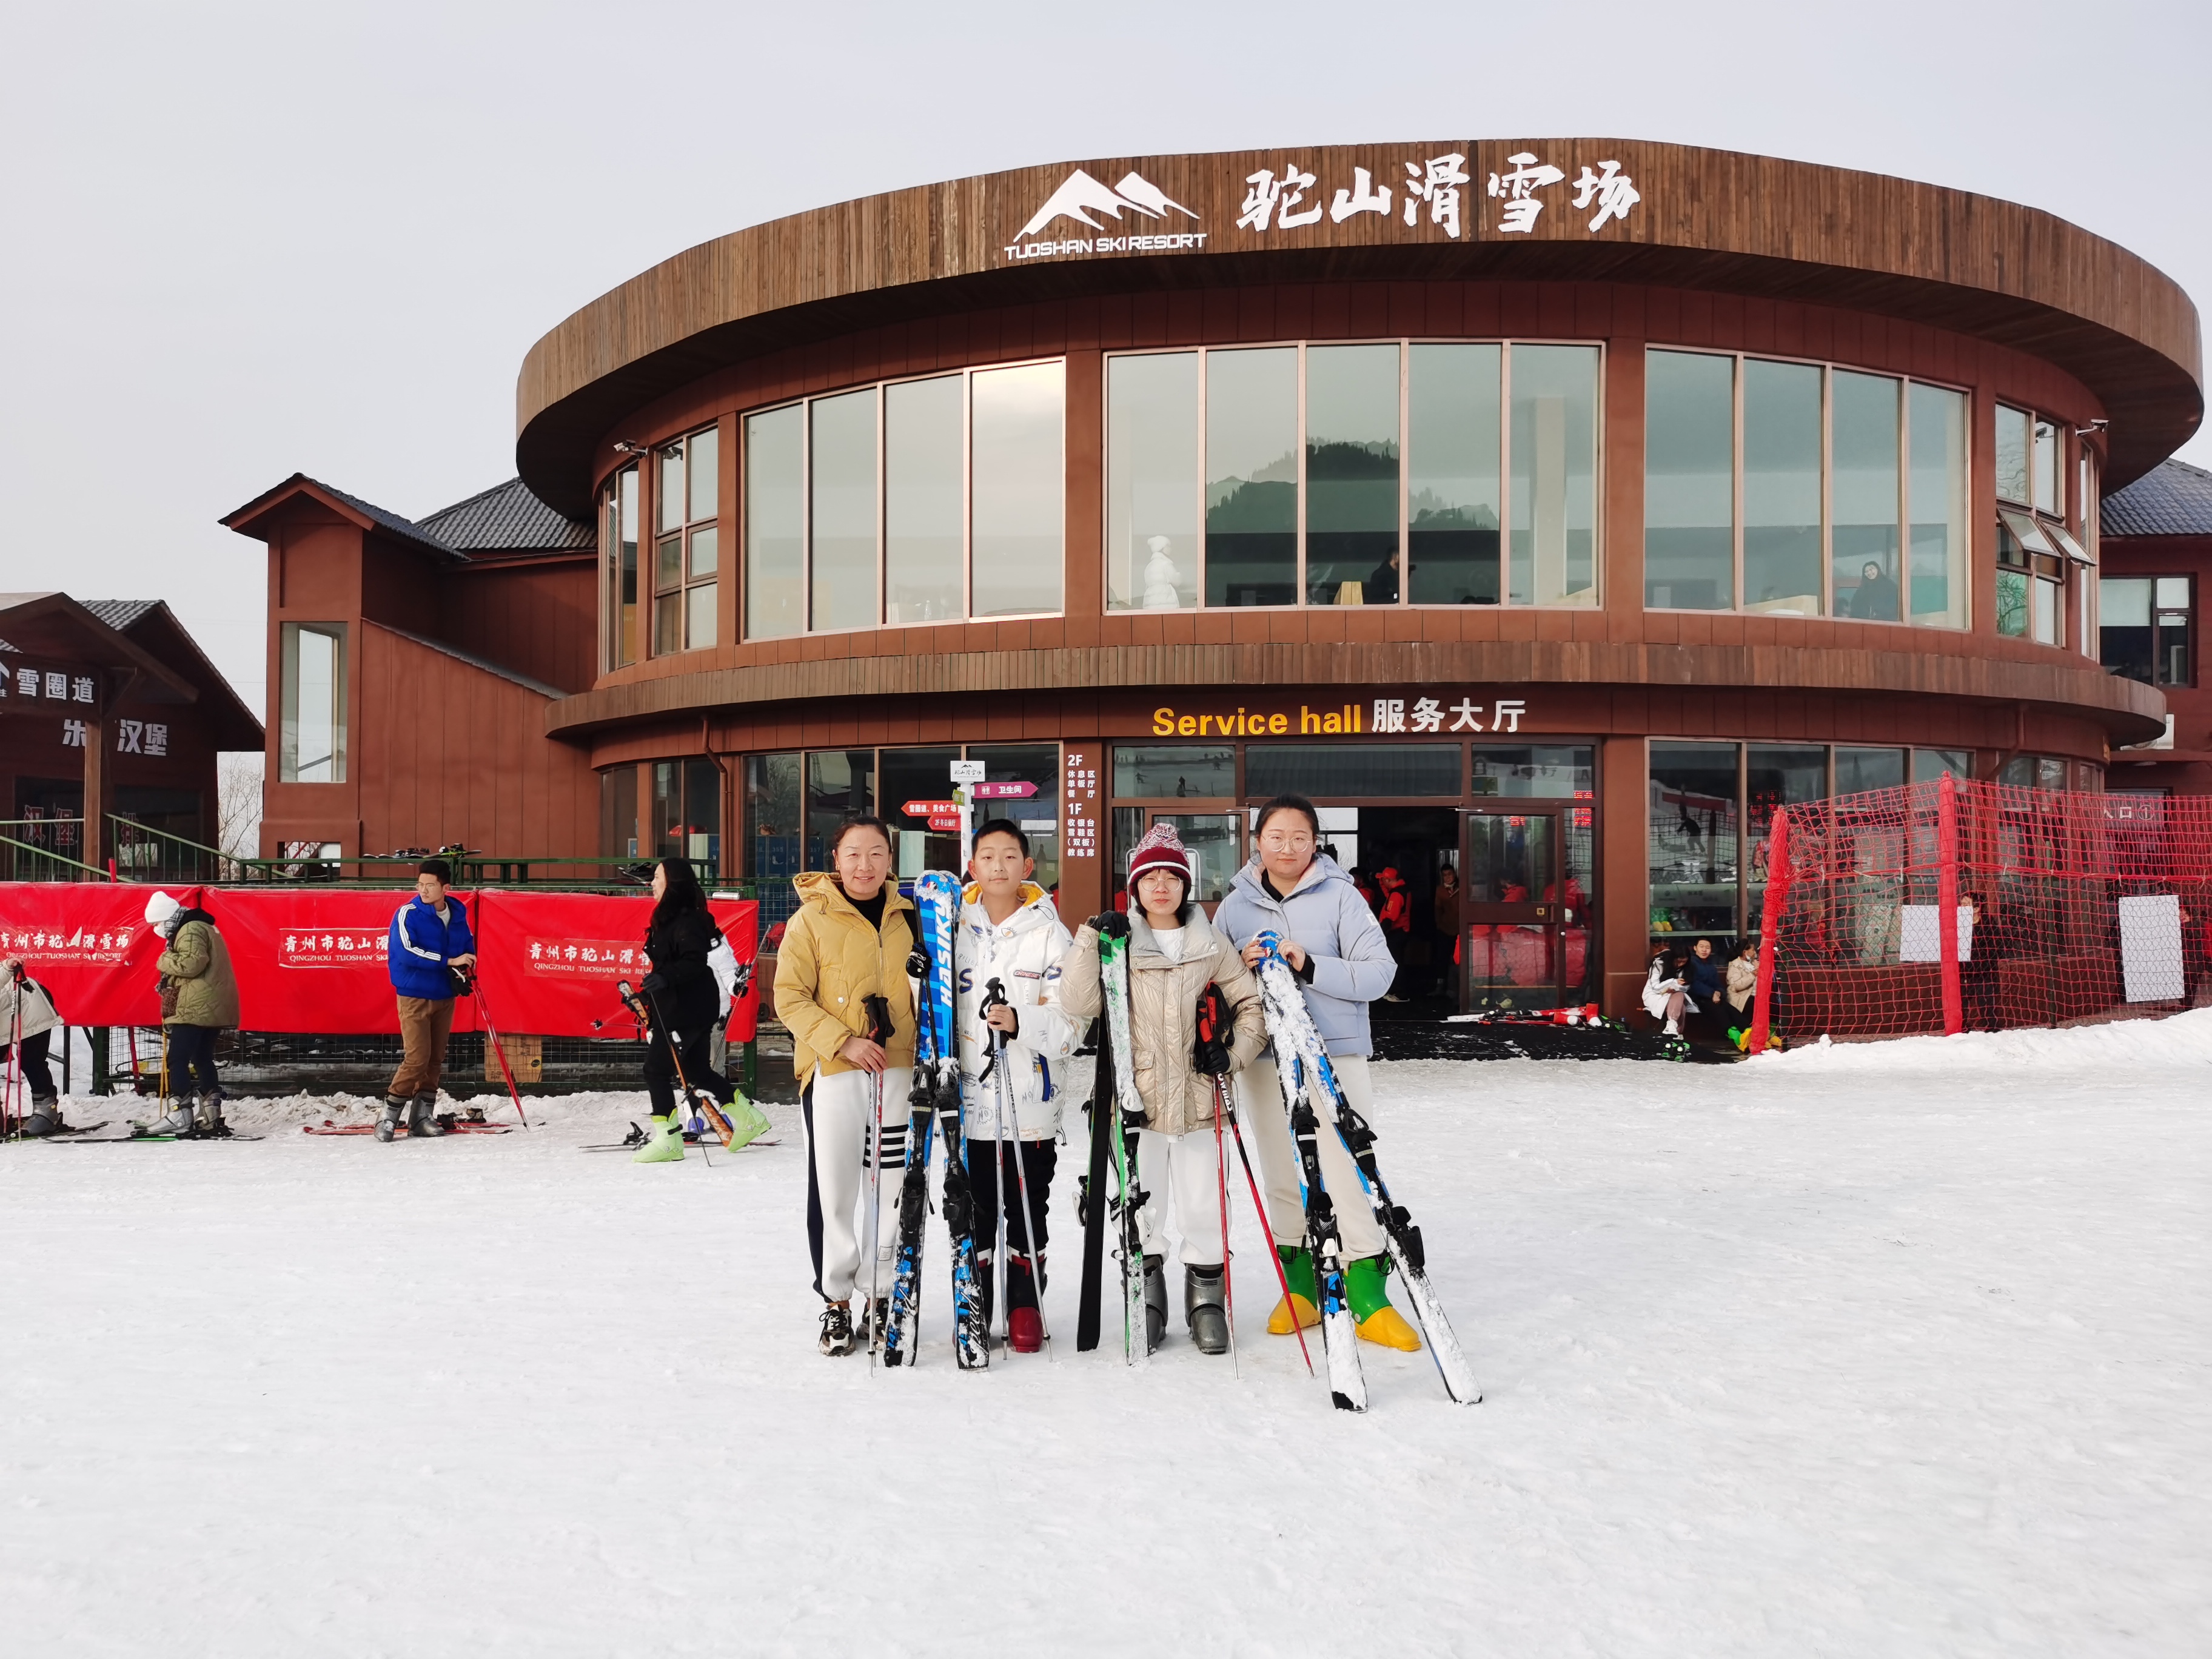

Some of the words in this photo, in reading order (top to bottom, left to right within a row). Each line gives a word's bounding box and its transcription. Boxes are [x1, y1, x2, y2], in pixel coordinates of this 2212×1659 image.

[1236, 153, 1641, 239] 驼山滑雪场
[1004, 239, 1093, 260] TUOSHAN
[1096, 236, 1126, 252] SKI
[1128, 233, 1207, 250] RESORT
[16, 668, 94, 703] 雪圈道
[1153, 707, 1288, 736] Service
[1301, 705, 1361, 734] hall
[1372, 697, 1526, 733] 服务大厅
[1067, 754, 1083, 766] 2F
[998, 785, 1022, 794] 卫生间
[1068, 803, 1082, 815] 1F
[289, 954, 332, 963] QINGZHOU
[534, 962, 575, 971] QINGZHOU
